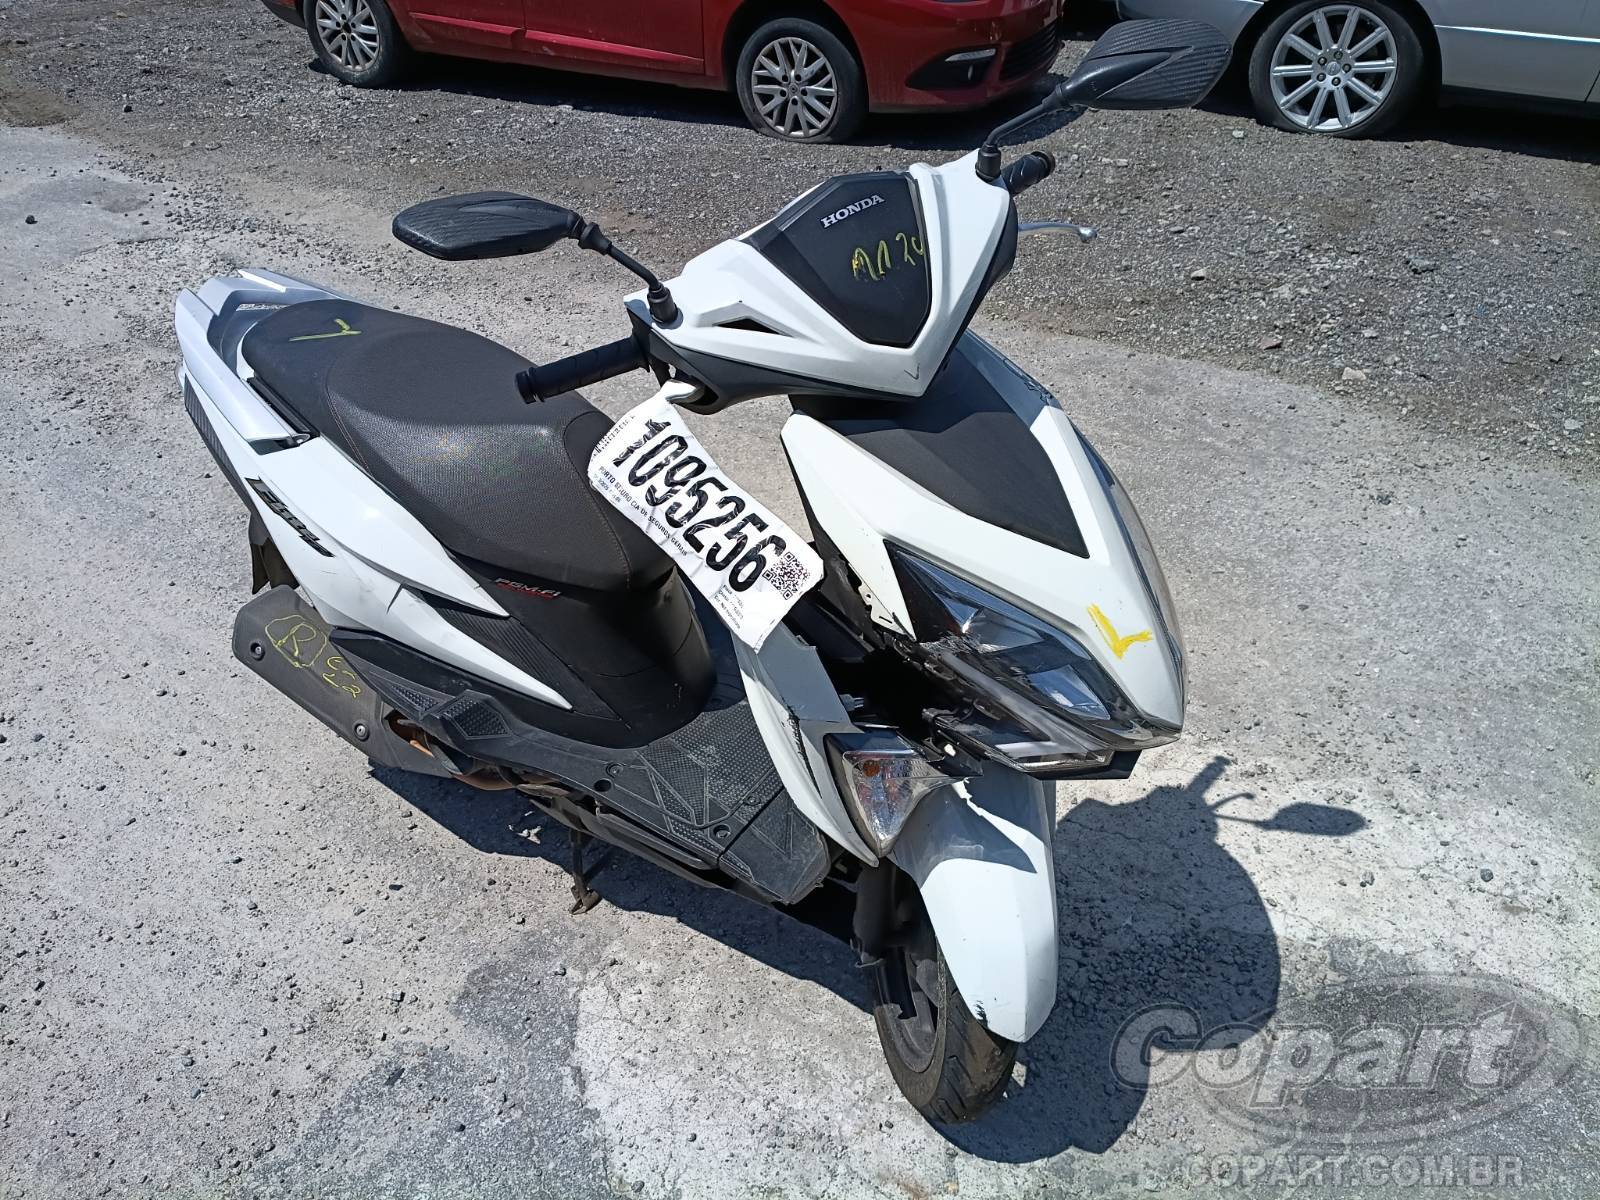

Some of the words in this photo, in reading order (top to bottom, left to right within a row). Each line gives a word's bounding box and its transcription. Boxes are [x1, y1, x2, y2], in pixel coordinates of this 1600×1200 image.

[820, 194, 886, 229] HONDA
[597, 465, 617, 484] PORTO
[629, 499, 641, 511] CIA
[638, 507, 649, 518] DE
[646, 514, 672, 539] SEGUROS
[612, 418, 787, 593] 1095256
